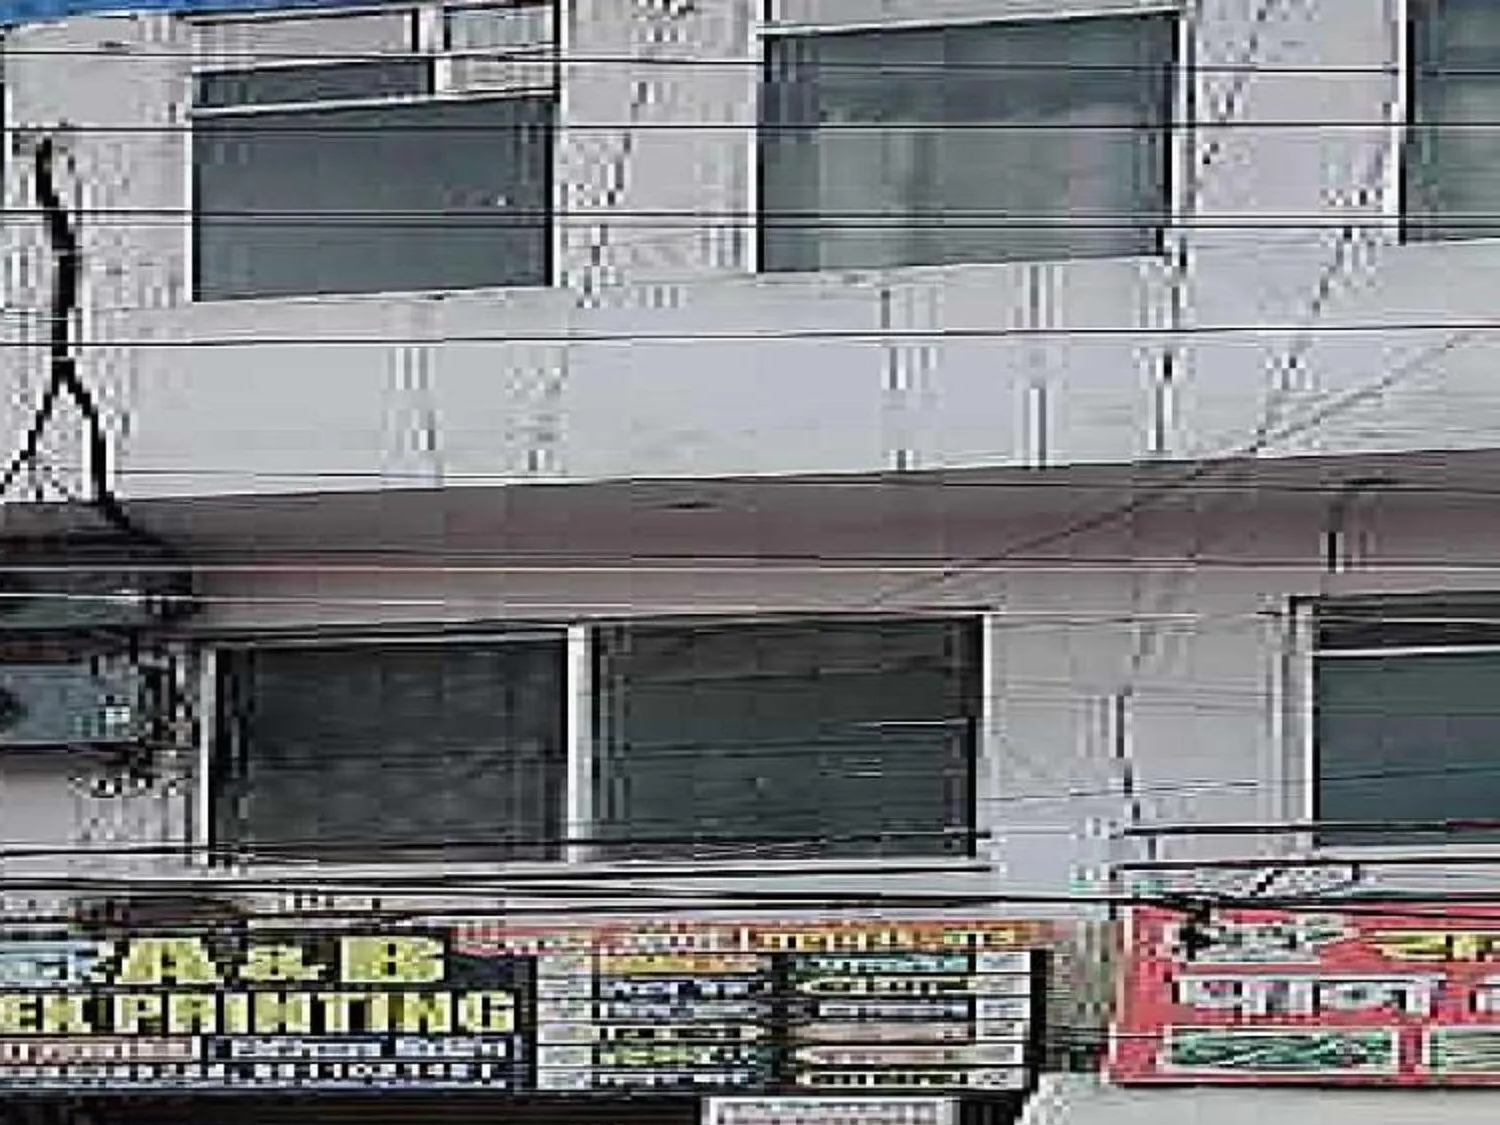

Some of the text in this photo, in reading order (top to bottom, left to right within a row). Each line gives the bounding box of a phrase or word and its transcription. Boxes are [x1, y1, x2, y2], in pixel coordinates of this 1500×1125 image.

[114, 936, 445, 985] A & B
[112, 990, 516, 1035] PRINTING
